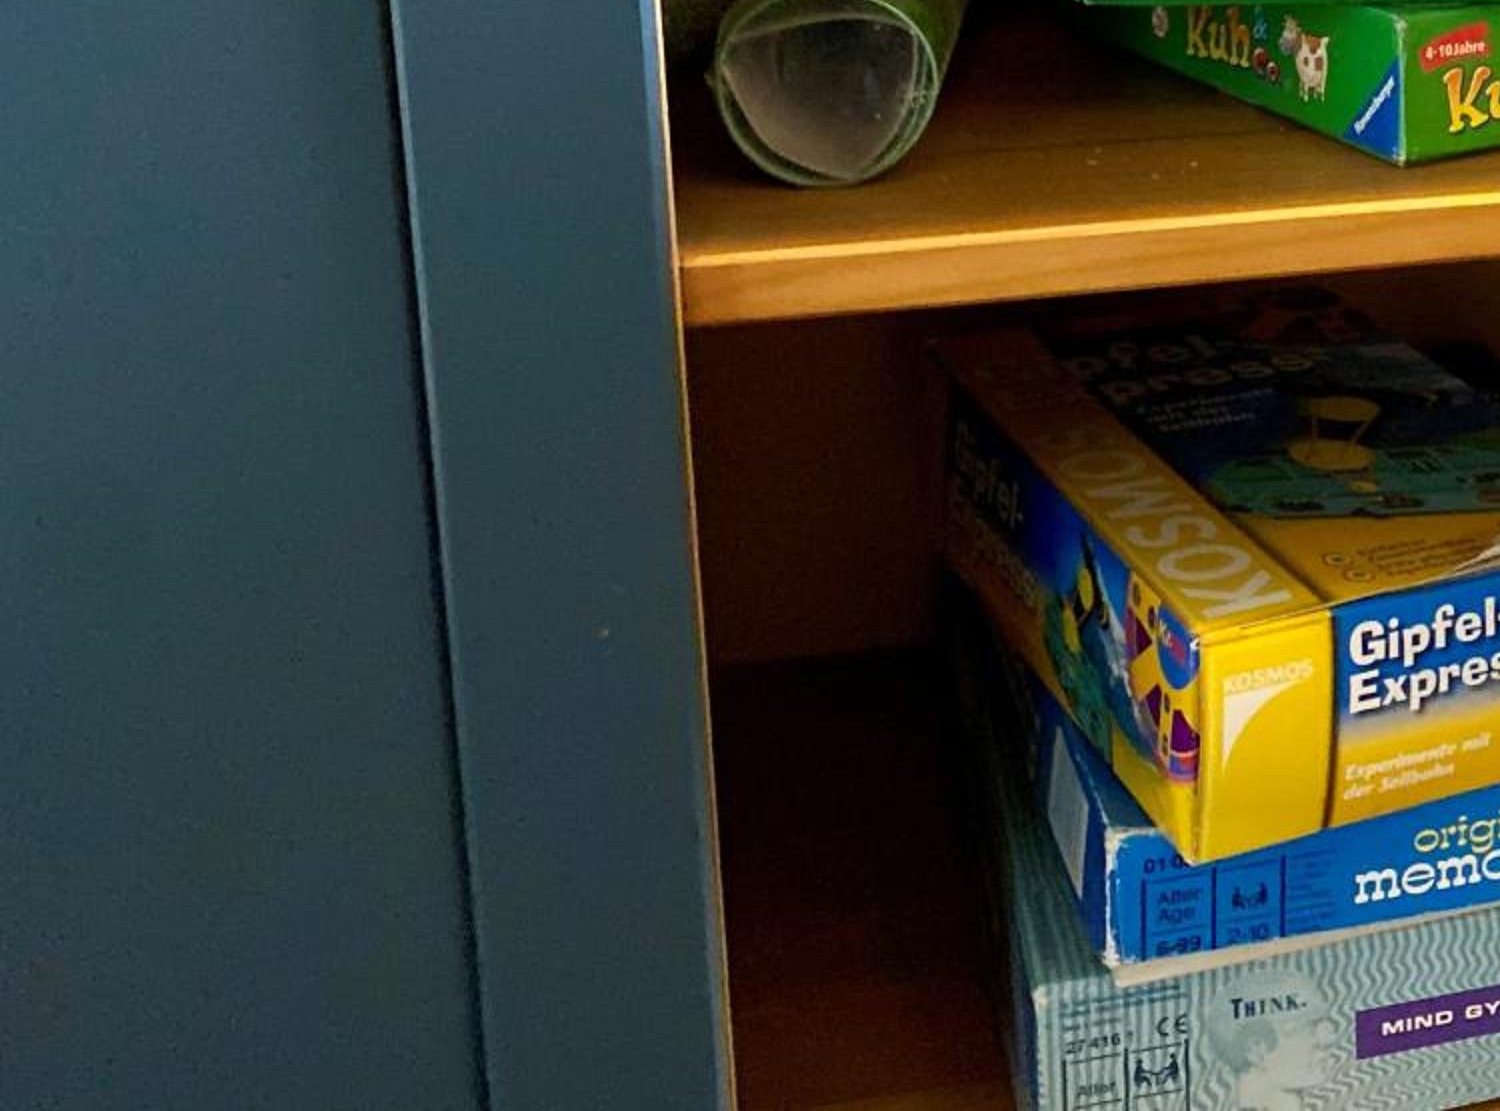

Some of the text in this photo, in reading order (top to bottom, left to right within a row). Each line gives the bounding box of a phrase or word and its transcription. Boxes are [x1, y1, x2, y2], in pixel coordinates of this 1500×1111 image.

[1184, 4, 1251, 69] Kuh
[1223, 658, 1312, 693] KOSMOS
[1381, 1010, 1453, 1037] MIND
